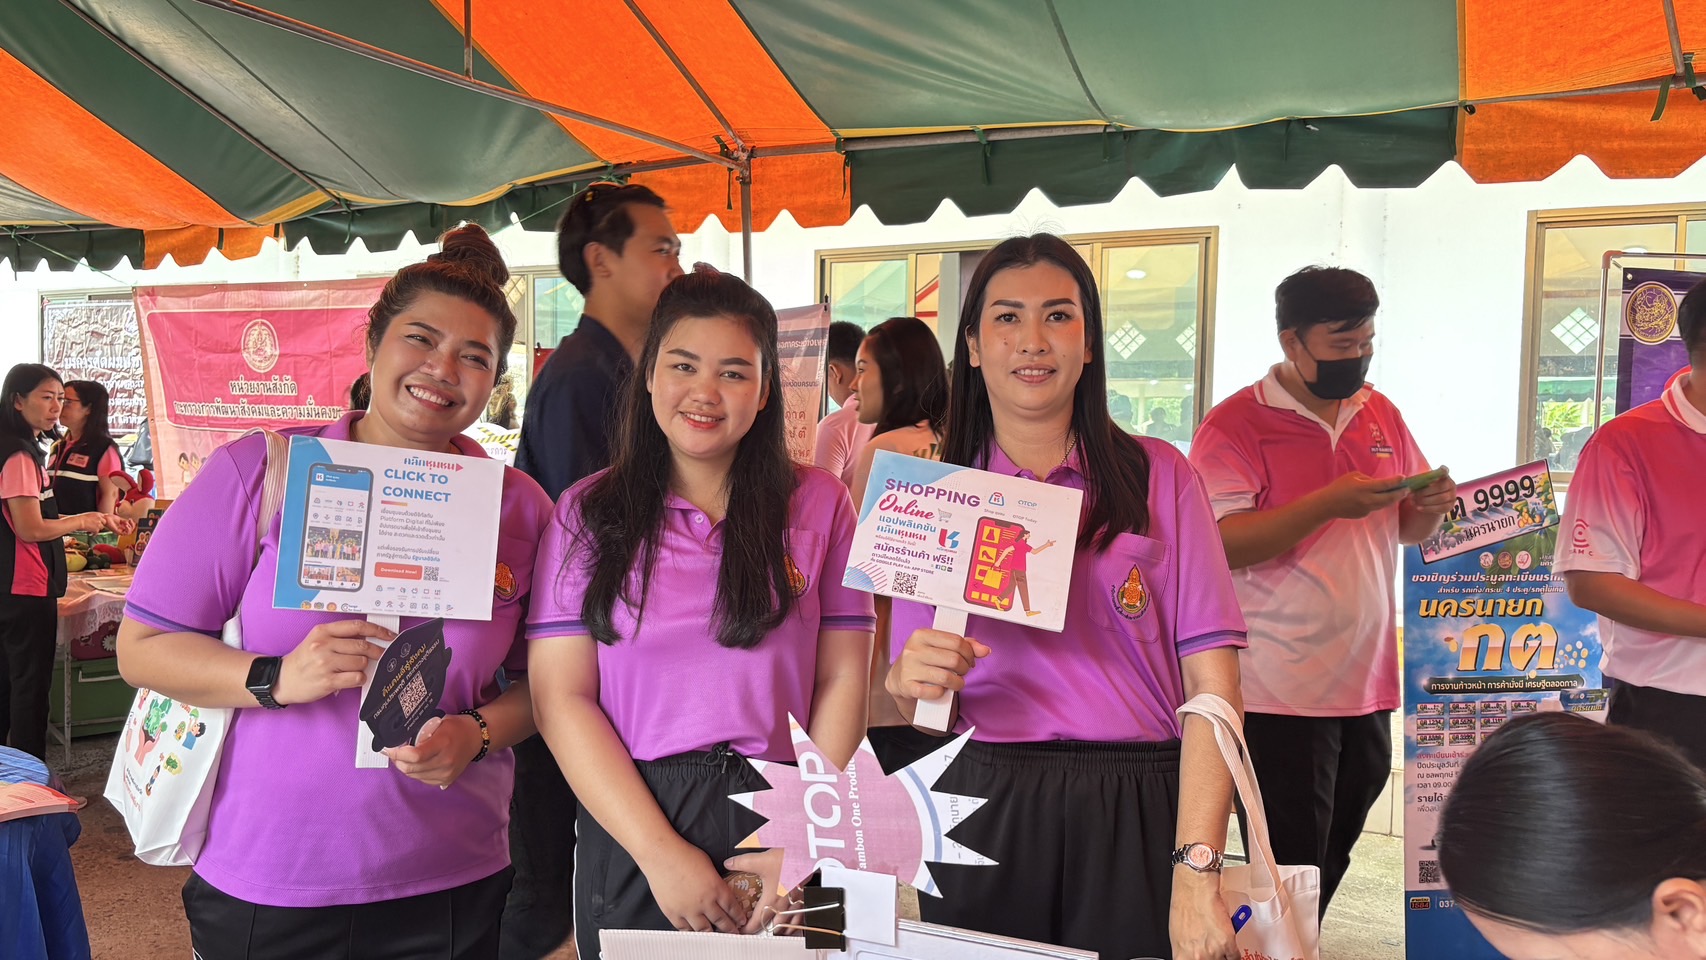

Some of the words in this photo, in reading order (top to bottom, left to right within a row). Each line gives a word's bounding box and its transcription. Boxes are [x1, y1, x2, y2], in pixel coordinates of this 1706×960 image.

[229, 376, 298, 395] หน่วยงานสังกัด
[174, 397, 341, 420] ระทรวงการพัฒนาสังคมและความมั่นคงข
[384, 468, 426, 483] CLICK
[429, 473, 448, 485] TO
[382, 486, 451, 502] CONNECT
[885, 478, 981, 507] SHOPPING
[1474, 475, 1535, 511] 9999
[879, 494, 935, 520] Online
[879, 514, 936, 533] แอปพลิเคชัน
[1465, 515, 1515, 539] นครนายก
[873, 542, 930, 561] สมัครร้านค้า
[932, 552, 954, 566] ฟรี!!
[876, 559, 892, 567] GOOGLE
[1418, 597, 1543, 618] นครนายก
[1456, 622, 1559, 672] กต
[1431, 680, 1486, 691] การงานก้าวหน้า
[1487, 677, 1523, 690] การค้ามั่งมี
[1525, 679, 1578, 691] เศรษฐีตลอดกาล
[1417, 760, 1459, 769] ปิดประมูลวันที่
[852, 802, 862, 827] One
